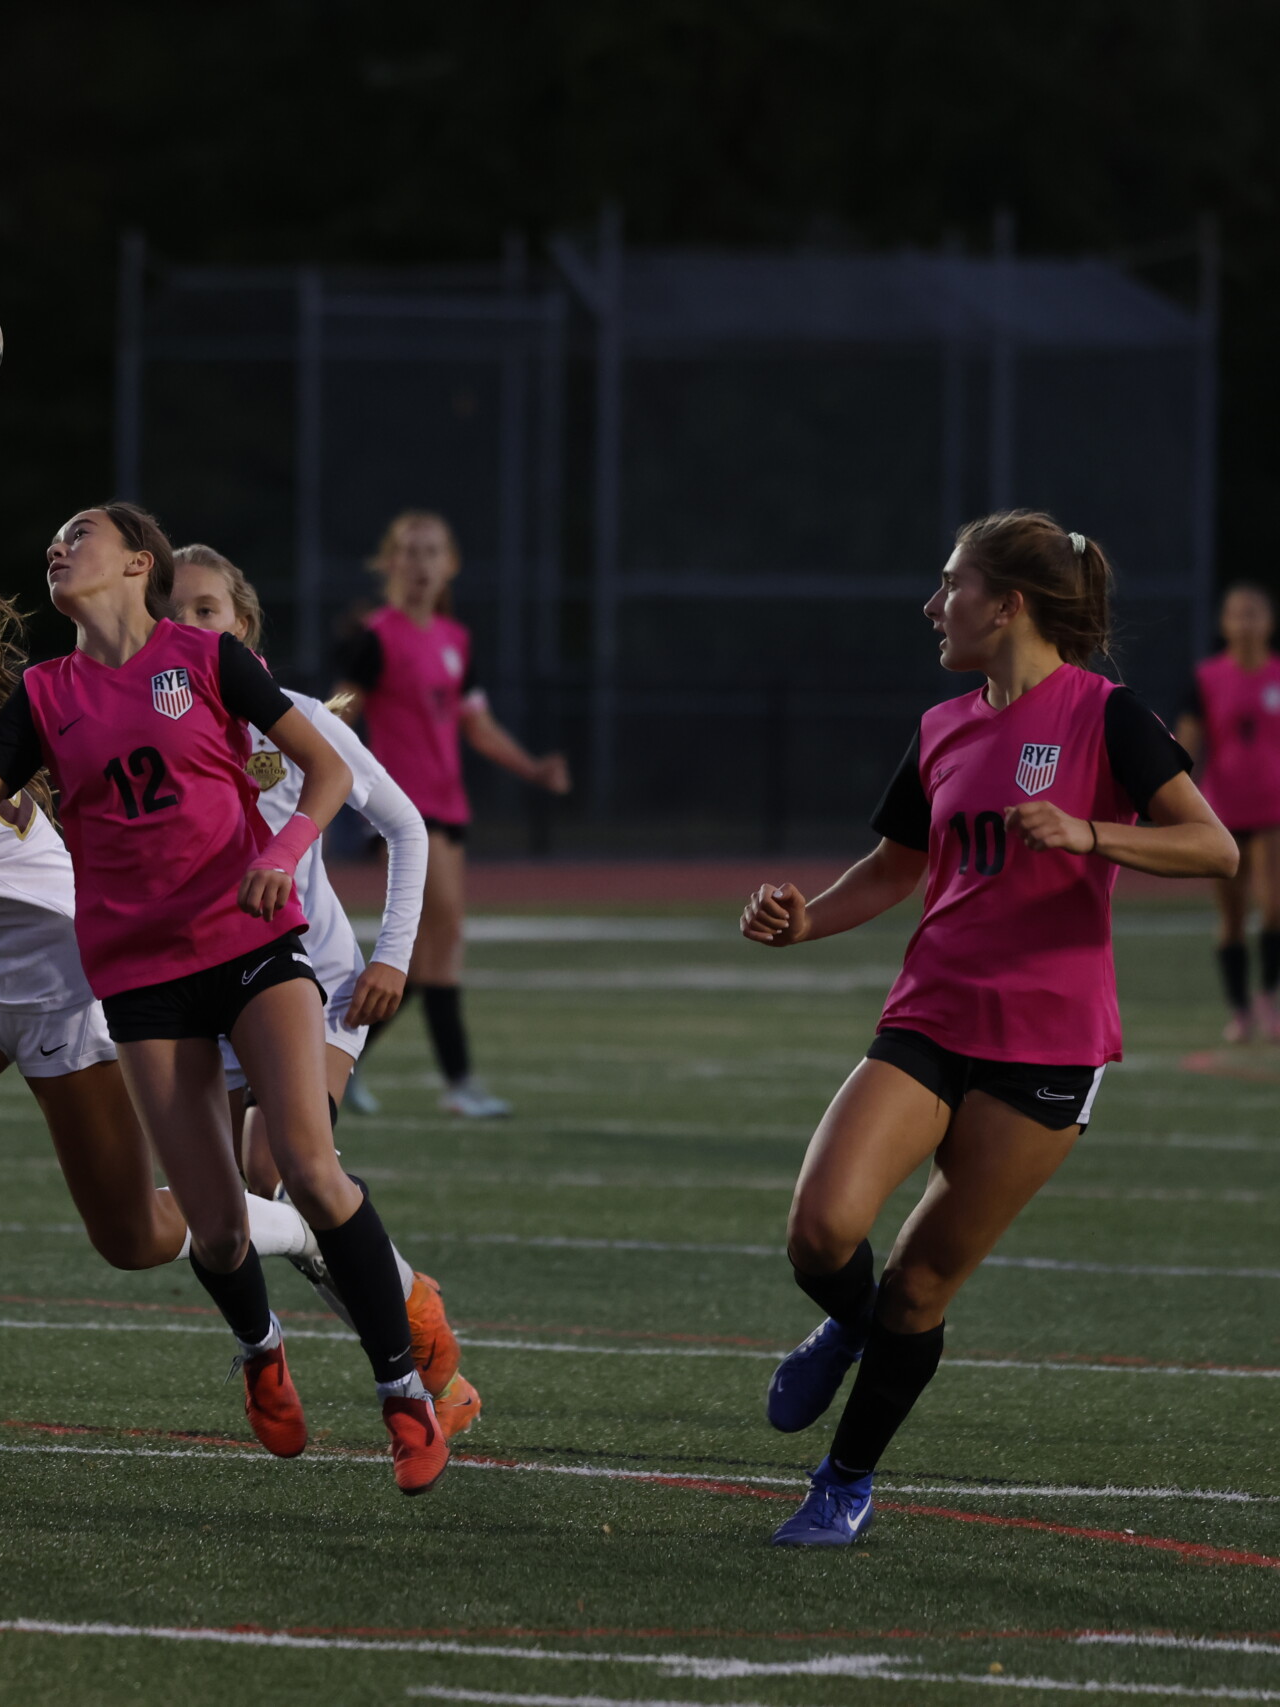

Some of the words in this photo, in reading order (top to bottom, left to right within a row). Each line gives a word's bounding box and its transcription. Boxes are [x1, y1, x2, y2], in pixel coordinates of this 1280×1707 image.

[153, 670, 187, 691] RYE
[1022, 745, 1059, 766] RYE
[103, 746, 179, 820] 12
[949, 811, 1006, 877] 10
